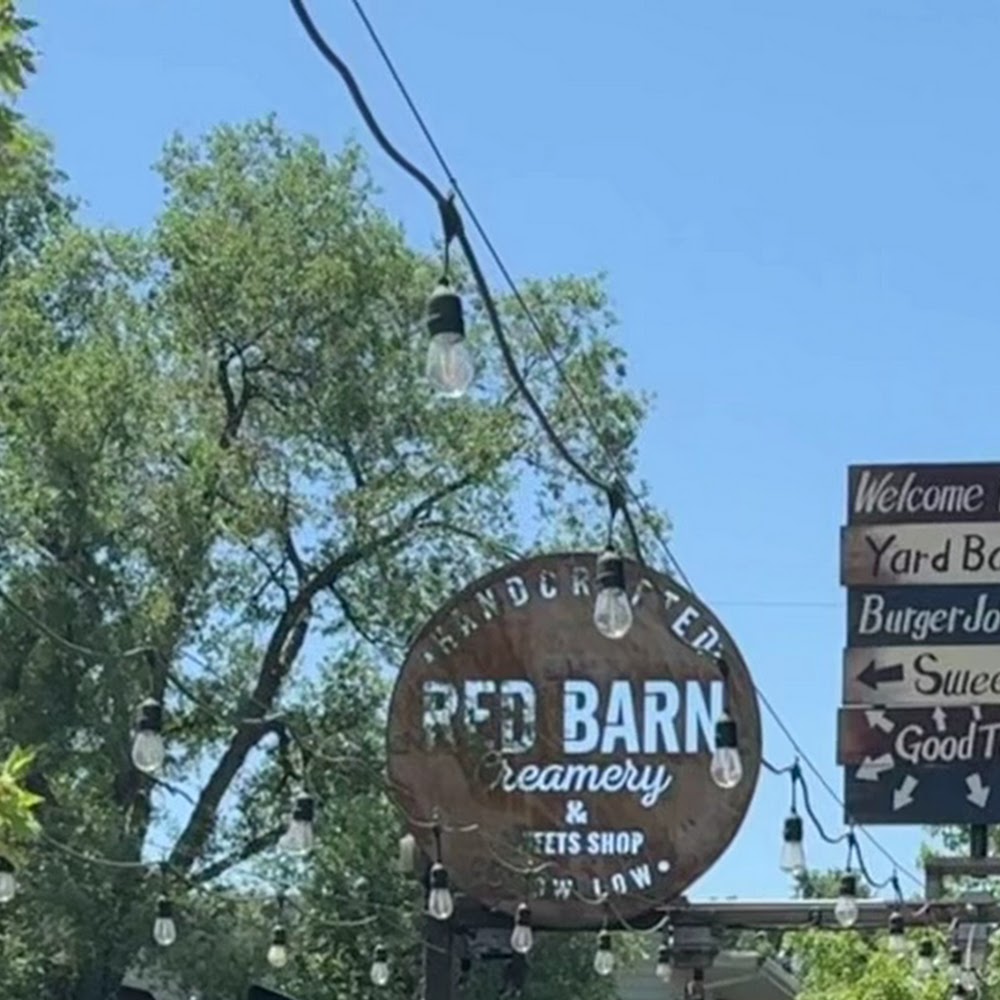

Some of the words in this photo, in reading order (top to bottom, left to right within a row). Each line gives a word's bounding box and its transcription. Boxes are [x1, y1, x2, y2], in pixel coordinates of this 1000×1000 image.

[854, 469, 985, 514] Welcome
[865, 533, 953, 577] Yard
[434, 566, 722, 656] HANDCRFTED
[563, 679, 725, 755] BARN
[895, 720, 977, 764] Good
[565, 800, 588, 825] &
[587, 831, 645, 855] SHOP
